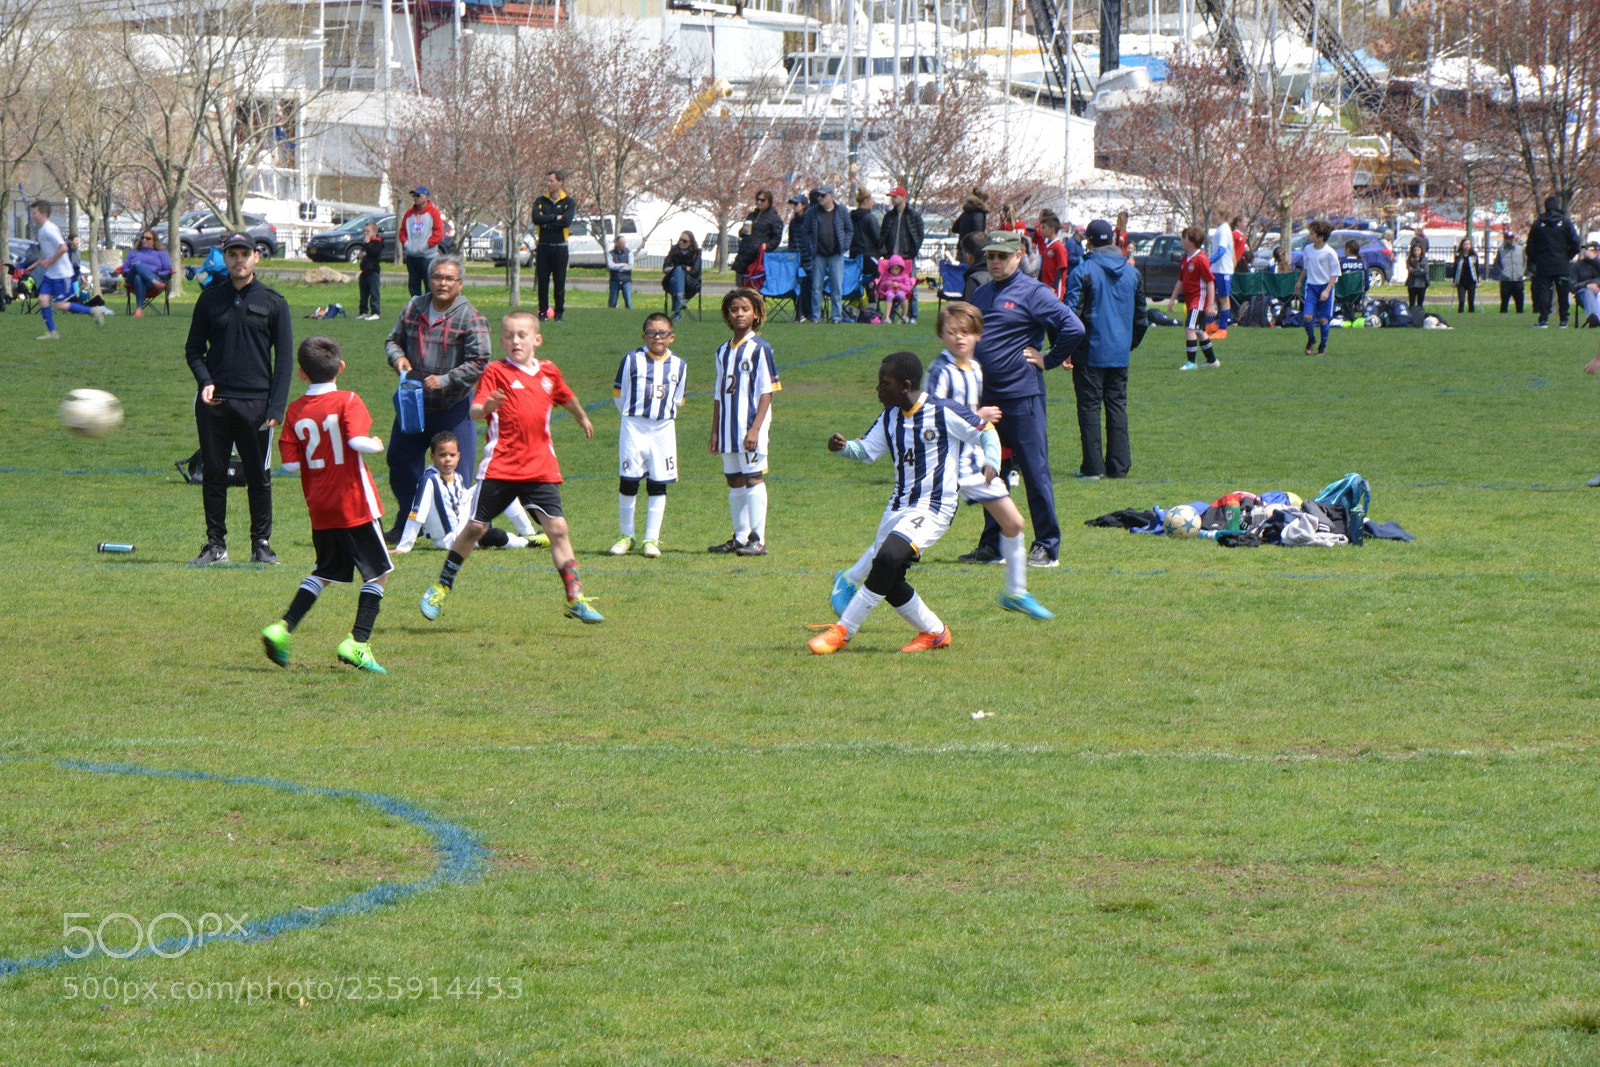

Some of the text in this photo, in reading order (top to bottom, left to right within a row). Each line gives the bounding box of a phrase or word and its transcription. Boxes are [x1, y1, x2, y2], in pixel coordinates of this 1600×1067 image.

[648, 383, 666, 400] 15
[294, 413, 345, 470] 21
[665, 456, 675, 471] 15
[744, 452, 759, 465] 12
[903, 447, 915, 467] 4
[910, 515, 926, 530] 4
